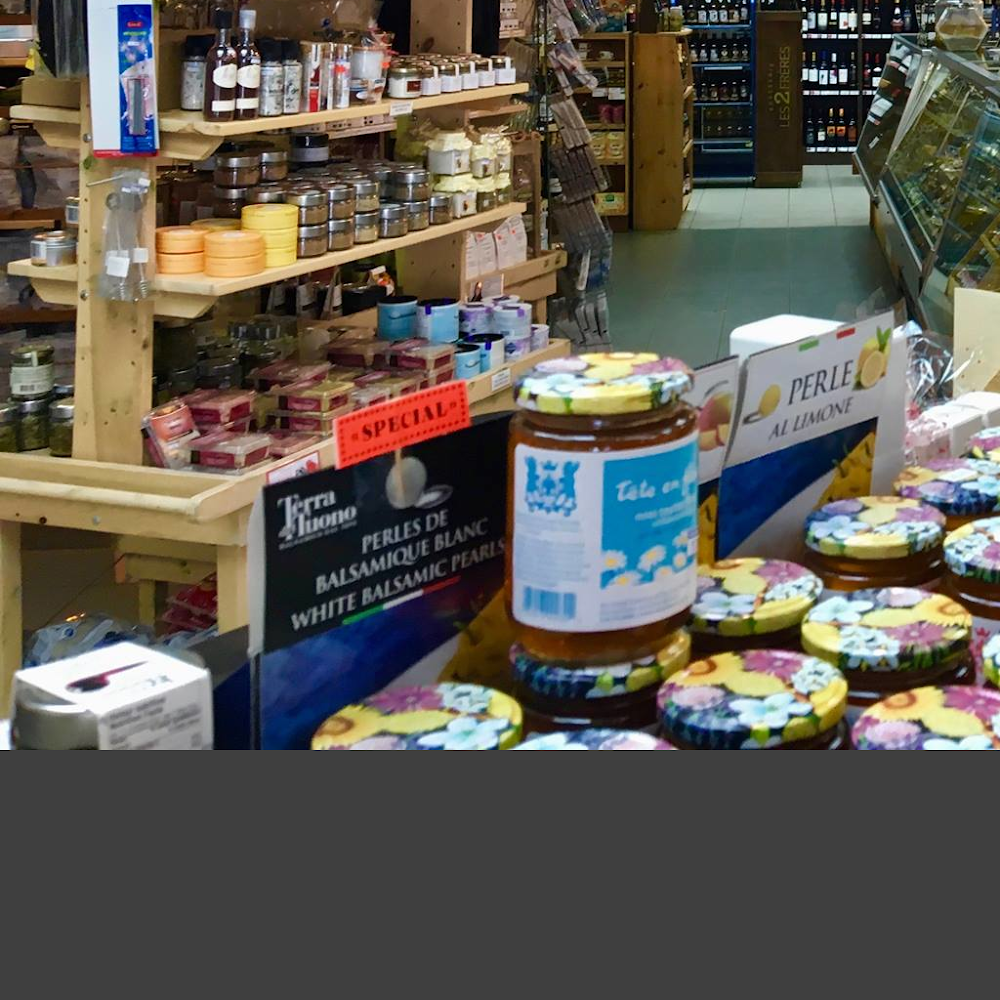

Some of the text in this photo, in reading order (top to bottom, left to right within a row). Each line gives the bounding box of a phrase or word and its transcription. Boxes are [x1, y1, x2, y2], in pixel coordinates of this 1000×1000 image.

[773, 91, 790, 104] 2
[788, 360, 854, 406] PERLE
[768, 397, 854, 441] AL LIMONE
[361, 518, 421, 554] PERLES
[425, 509, 448, 531] DE
[315, 517, 489, 595] BALSAMIQUE BLANC
[290, 593, 357, 631] WHITE
[361, 559, 448, 606] BALSAMIC
[451, 540, 506, 572] PEARLS
